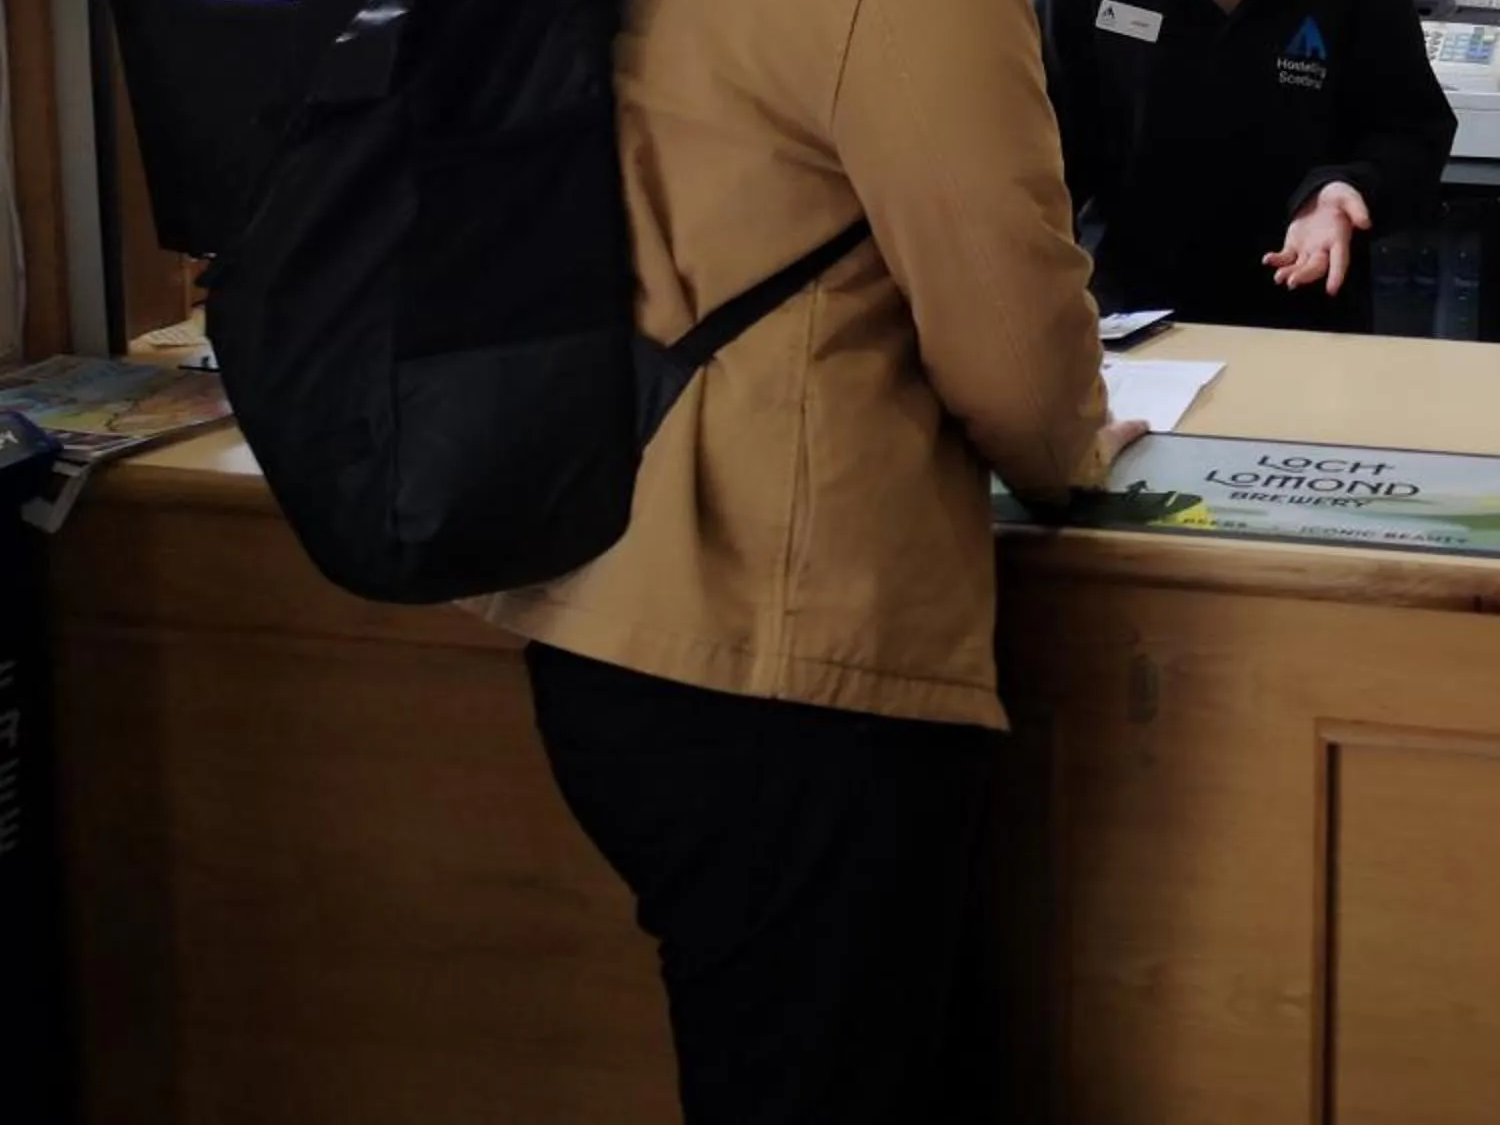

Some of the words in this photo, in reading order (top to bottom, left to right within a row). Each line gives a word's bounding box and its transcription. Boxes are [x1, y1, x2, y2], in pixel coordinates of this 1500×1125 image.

[1257, 455, 1396, 476] LOCH
[1203, 469, 1421, 498] LOMOND
[1228, 490, 1376, 509] BREWERY
[1299, 525, 1379, 540] ICONIC
